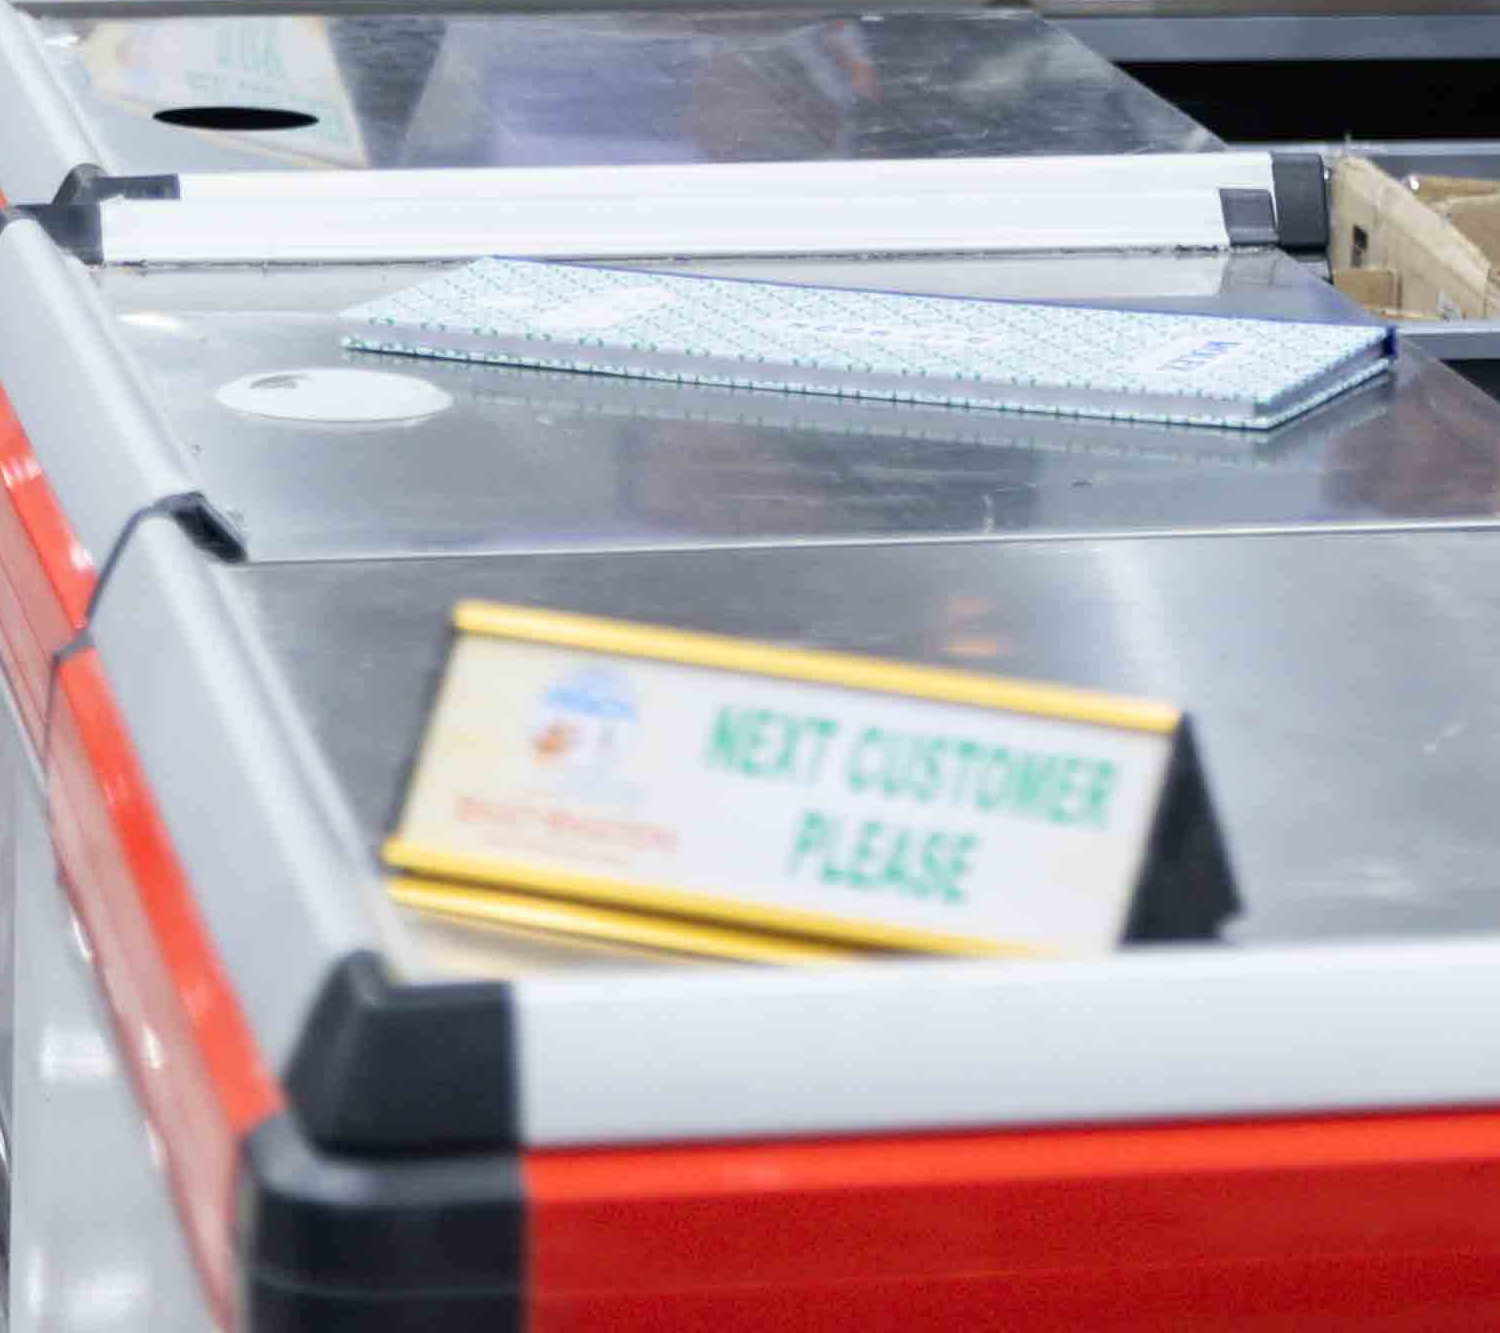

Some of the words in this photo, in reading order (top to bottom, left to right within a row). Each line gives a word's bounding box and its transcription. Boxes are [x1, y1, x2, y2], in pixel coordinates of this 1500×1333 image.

[707, 706, 838, 780] NEXT
[846, 726, 1117, 827] CUSTOMER
[791, 813, 977, 903] PLEASE
